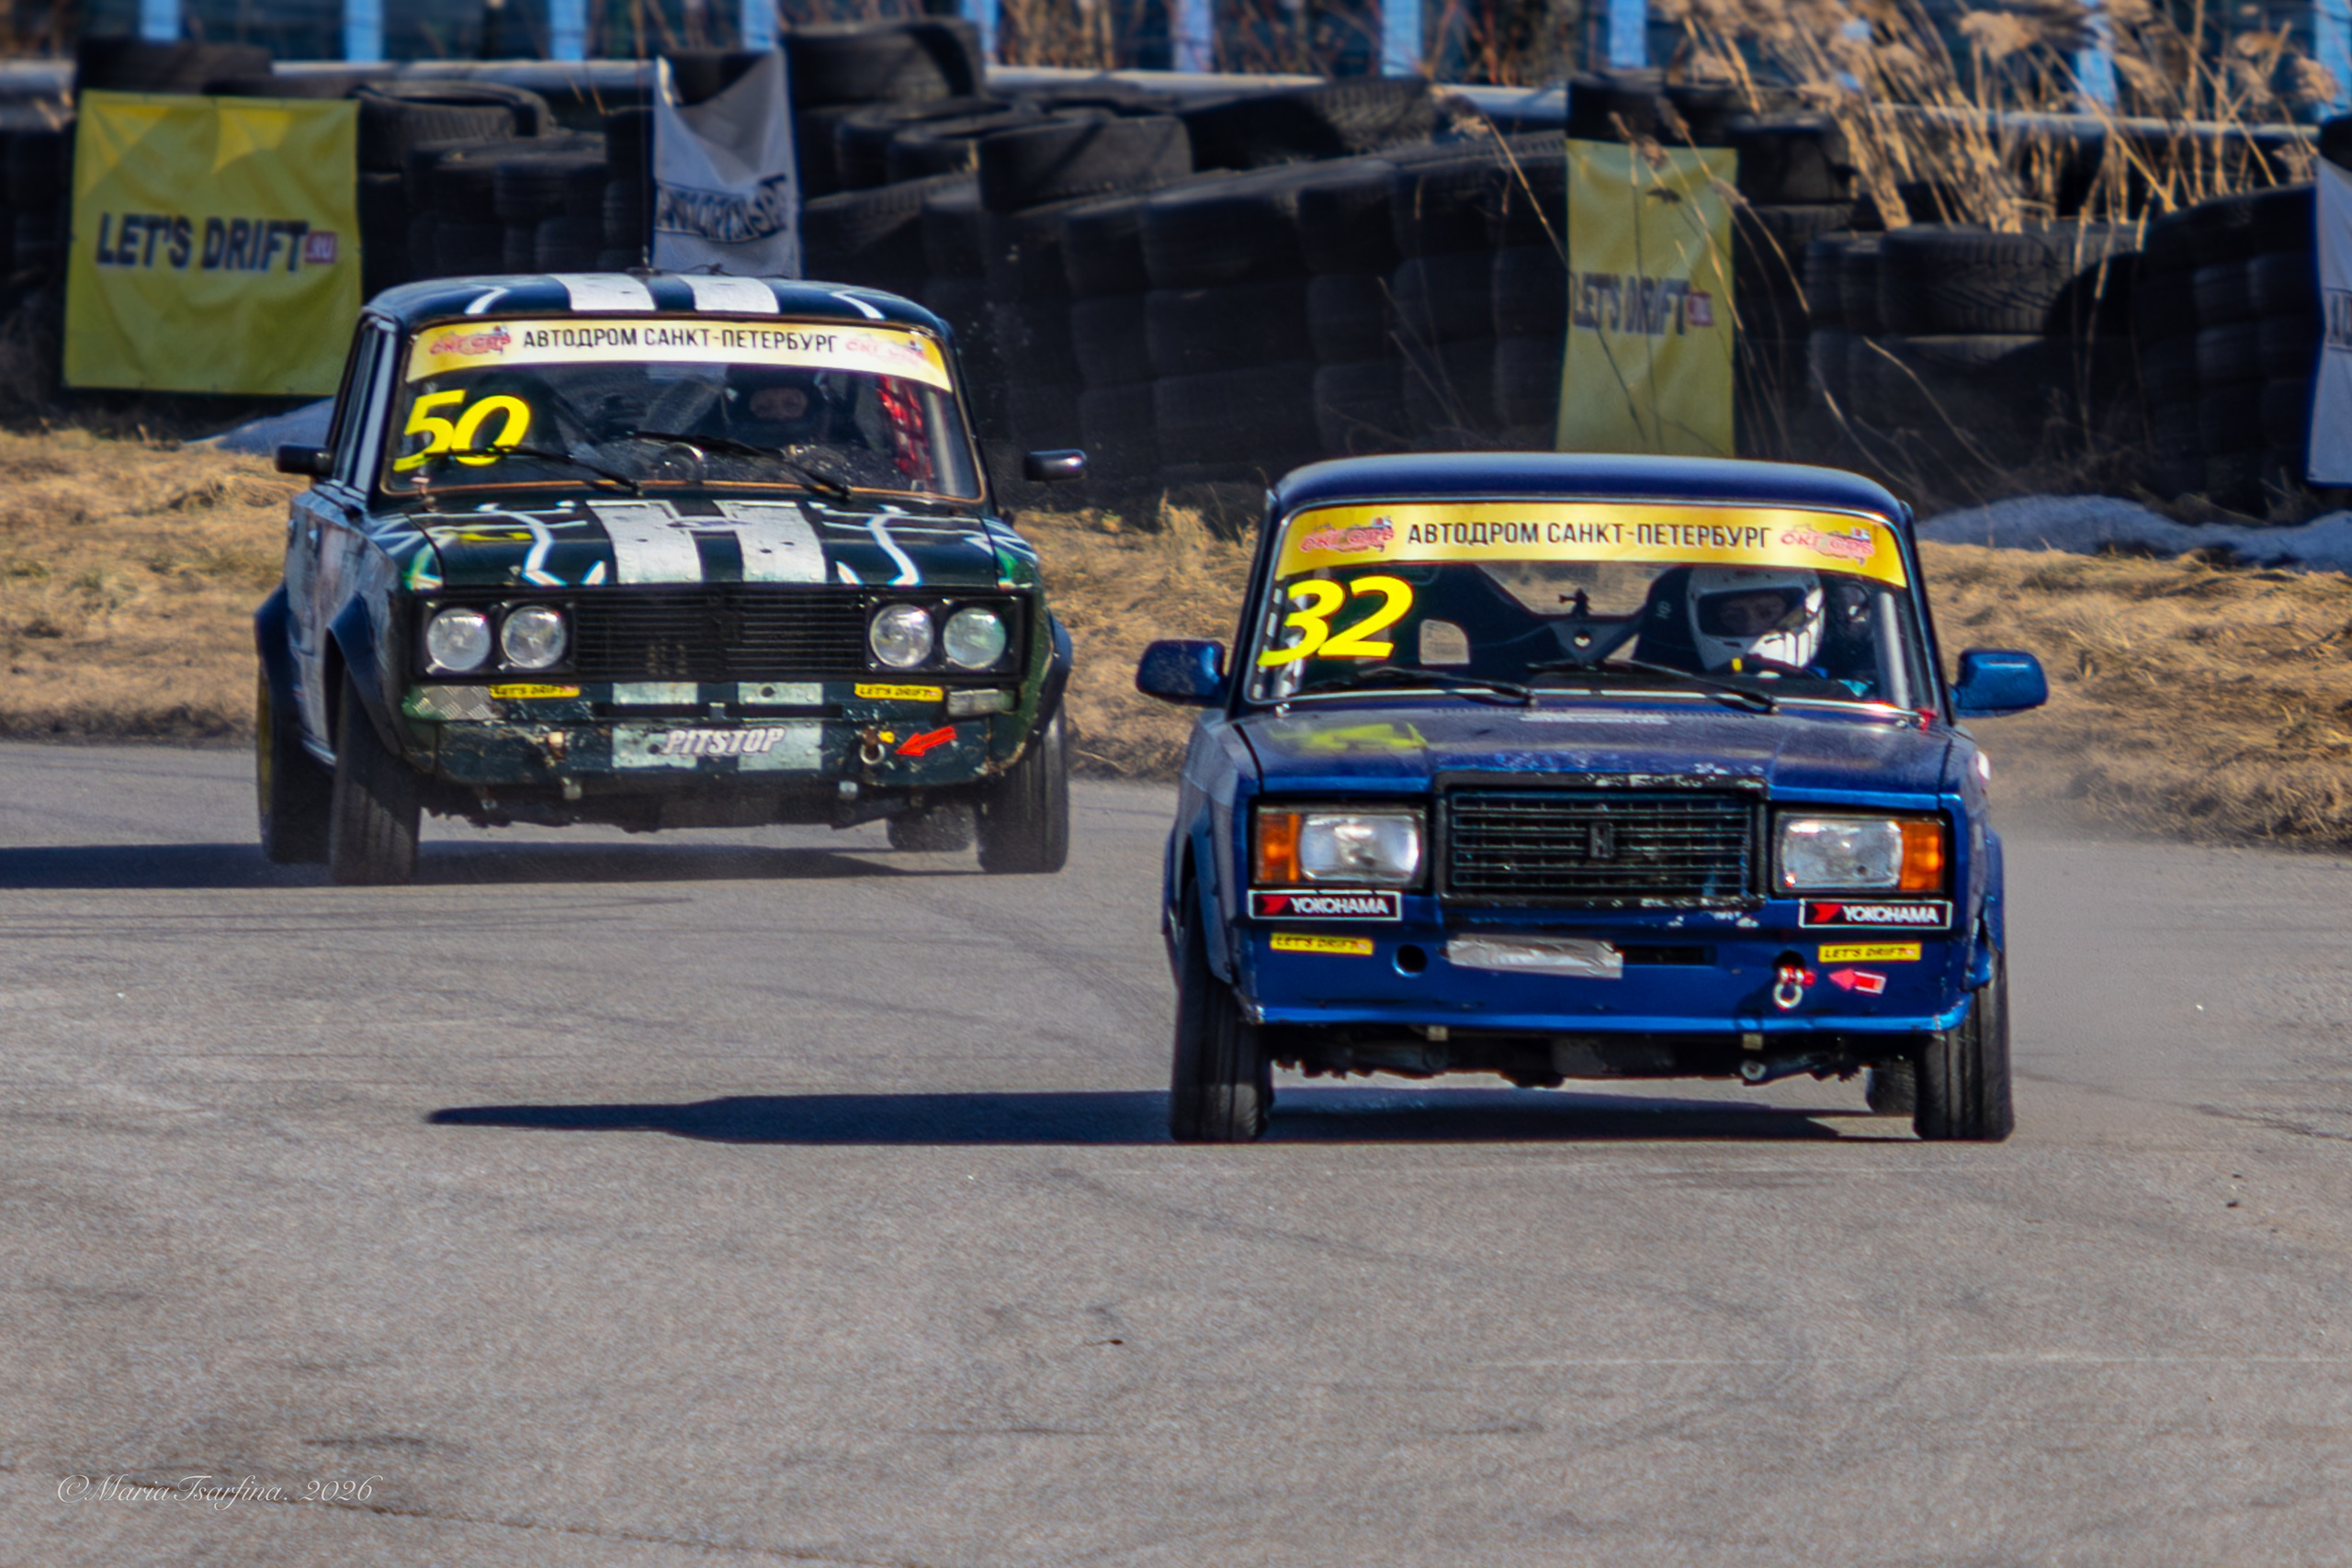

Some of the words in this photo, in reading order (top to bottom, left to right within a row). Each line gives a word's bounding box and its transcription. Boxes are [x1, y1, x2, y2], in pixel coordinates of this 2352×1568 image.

[96, 211, 194, 269] LET'S
[523, 327, 638, 349] АВТОДРОМ
[644, 328, 838, 353] САНКТ-ПЕТЕРБУРГ
[392, 389, 531, 471] 50
[1408, 522, 1539, 547] АВТОДРОМ
[1547, 522, 1771, 548] САНКТ-ПЕТЕРБУРГ
[1256, 575, 1415, 667] 32
[660, 727, 786, 757] PITSTOP
[1290, 897, 1390, 914] YOKOHAMA
[1842, 905, 1940, 923] YOKOHAMA
